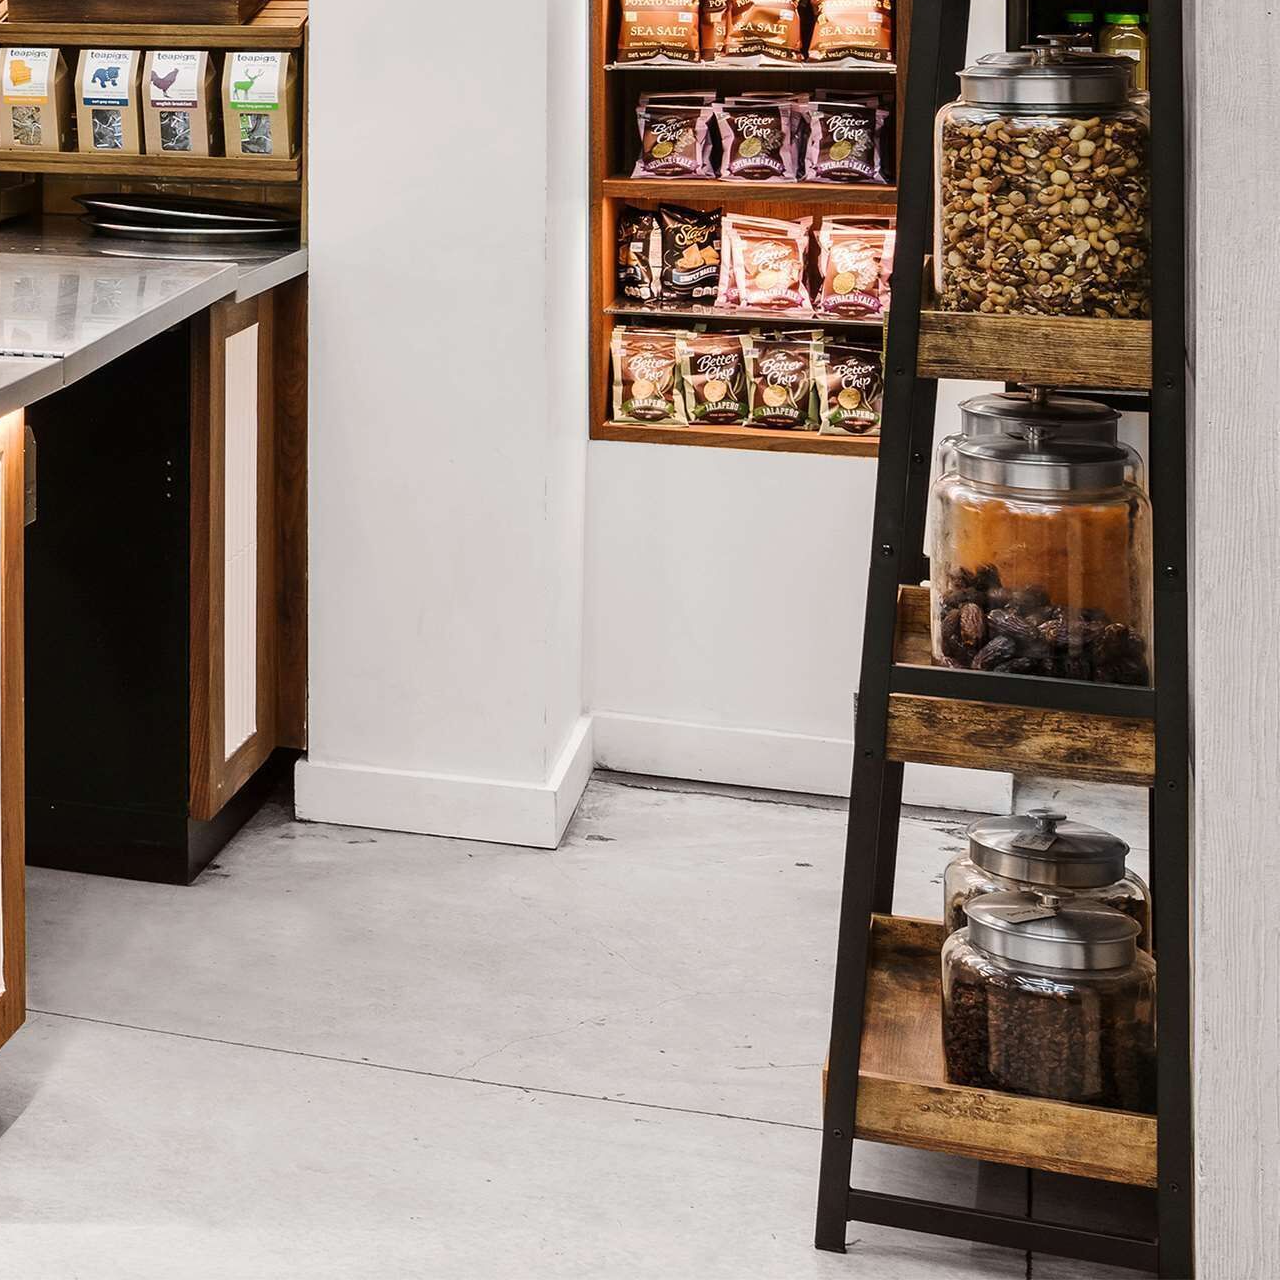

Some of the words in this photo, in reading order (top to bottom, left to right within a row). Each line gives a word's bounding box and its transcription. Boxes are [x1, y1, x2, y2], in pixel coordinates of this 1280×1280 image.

[630, 25, 655, 36] SEA
[656, 26, 688, 37] SALT
[732, 21, 755, 32] SEA
[757, 22, 787, 34] SALT
[819, 24, 844, 37] SEA
[845, 24, 878, 36] SALT
[651, 118, 690, 134] Better
[734, 115, 774, 131] Better
[826, 115, 869, 132] Better
[656, 128, 683, 144] Chip
[743, 124, 770, 139] Chip
[832, 125, 863, 143] Chip
[648, 158, 673, 169] SPINACH
[676, 156, 692, 168] KALE
[732, 158, 761, 170] SPINACH
[763, 158, 781, 170] KALE
[820, 160, 850, 172] SPINACH
[853, 161, 870, 173] KALE
[675, 223, 716, 246] Stacy's
[826, 295, 855, 306] SPINACH
[858, 296, 876, 307] KALE
[628, 355, 669, 372] Better
[697, 353, 738, 372] Better
[776, 353, 787, 361] The
[845, 359, 858, 367] The
[637, 367, 664, 383] Chip
[704, 364, 735, 382] Chip
[759, 358, 804, 376] Better
[832, 363, 875, 379] Better
[766, 370, 798, 387] Chip
[841, 374, 872, 390] Chip
[704, 401, 740, 412] JALAPEÑO
[762, 406, 799, 418] JALAPEÑO
[840, 409, 876, 420] JALAPEÑO
